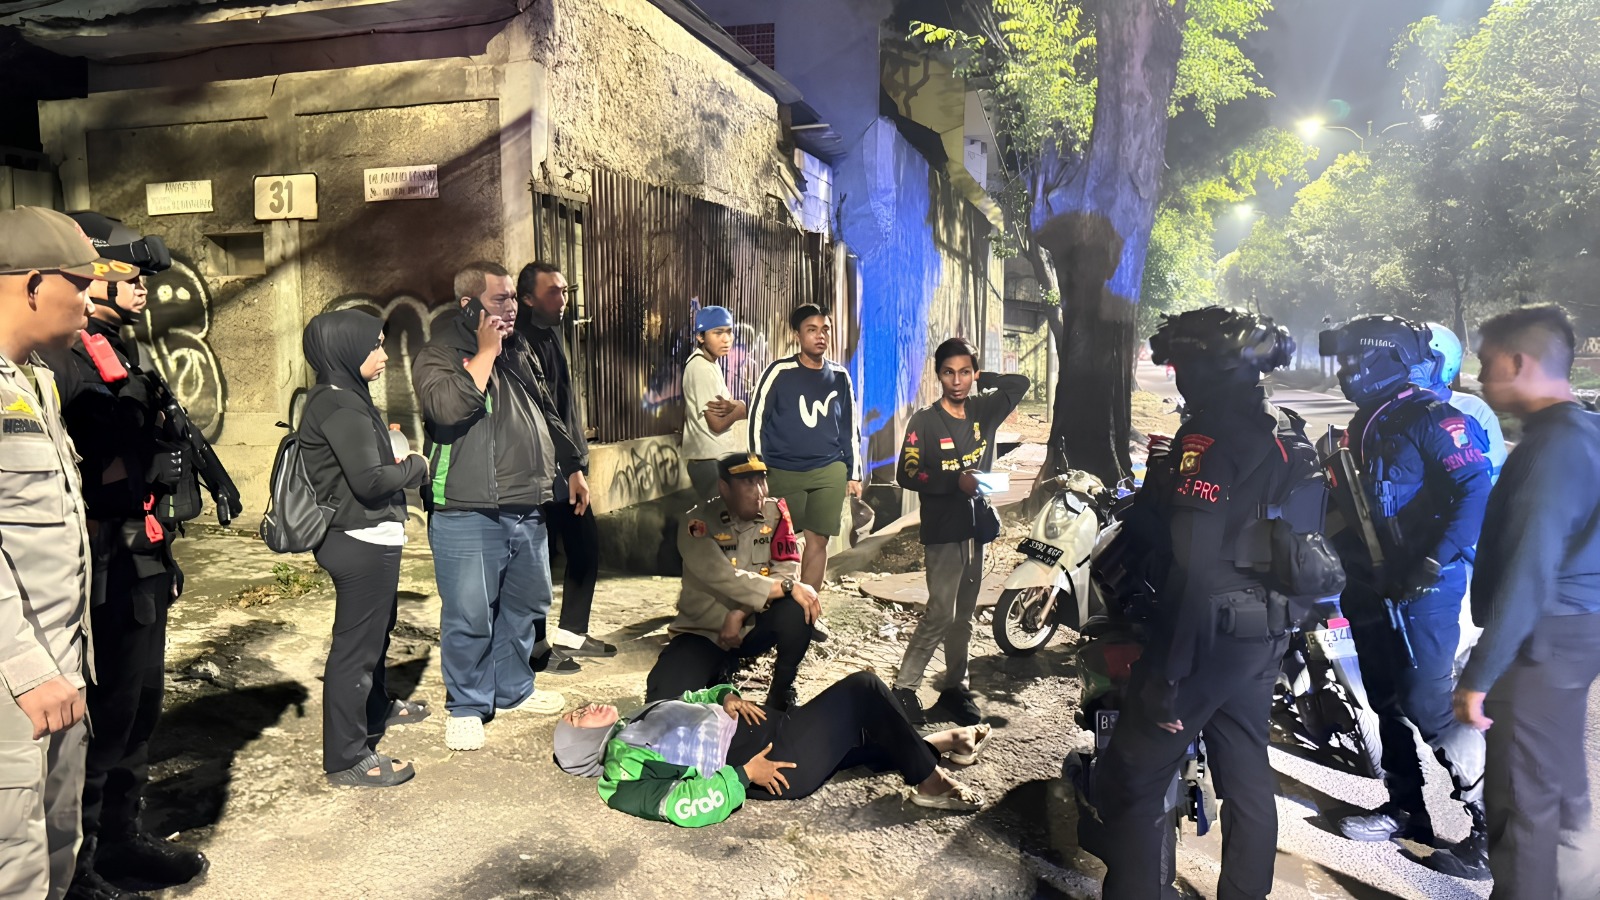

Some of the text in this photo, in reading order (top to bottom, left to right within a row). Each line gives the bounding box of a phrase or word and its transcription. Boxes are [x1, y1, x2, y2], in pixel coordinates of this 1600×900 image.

[269, 180, 293, 213] 31
[1191, 480, 1220, 503] PRC
[674, 787, 725, 820] Grab
